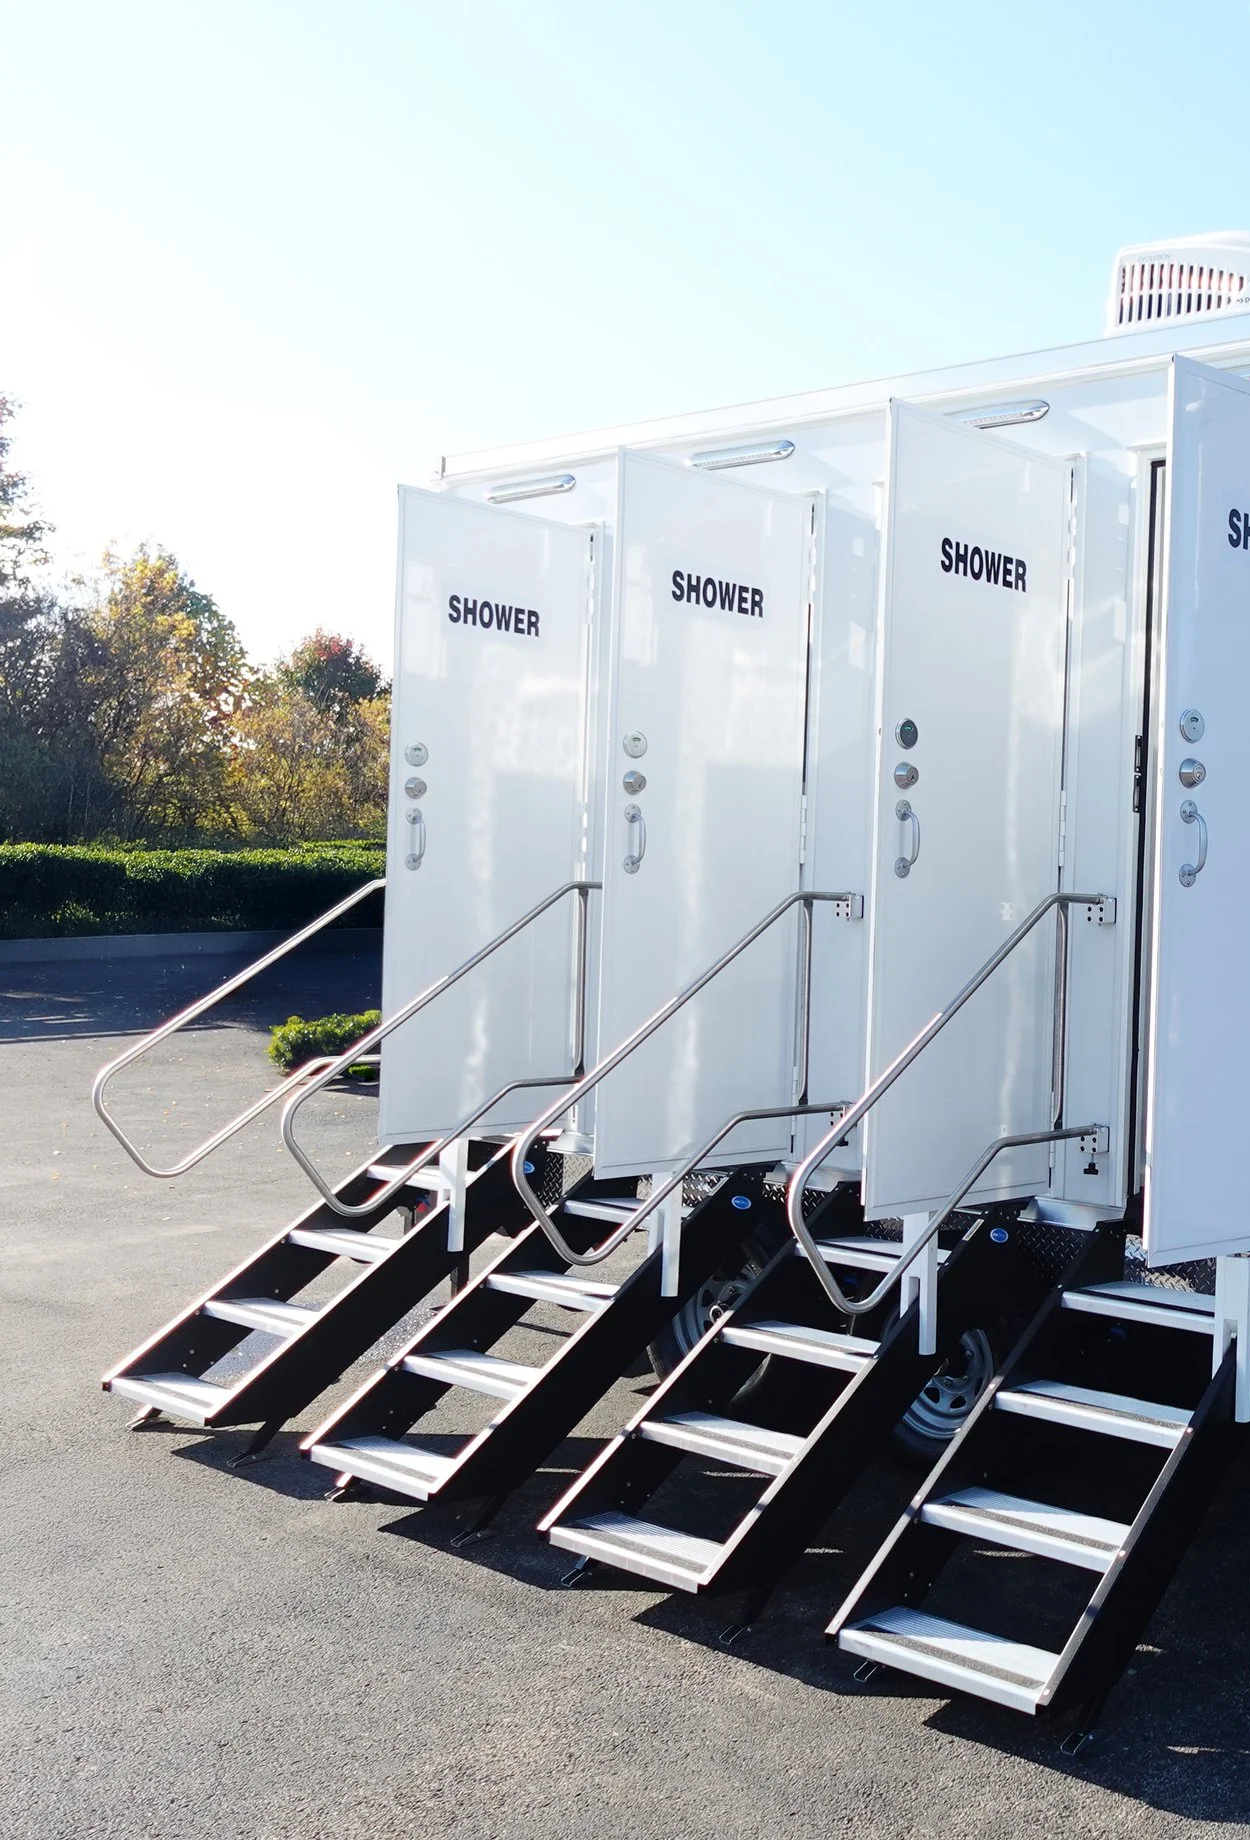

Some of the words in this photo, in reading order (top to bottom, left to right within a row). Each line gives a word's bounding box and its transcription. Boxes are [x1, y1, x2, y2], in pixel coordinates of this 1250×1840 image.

[940, 537, 1027, 593] SHOWER
[448, 594, 540, 637] SHOWER
[671, 569, 764, 618] SHOWER
